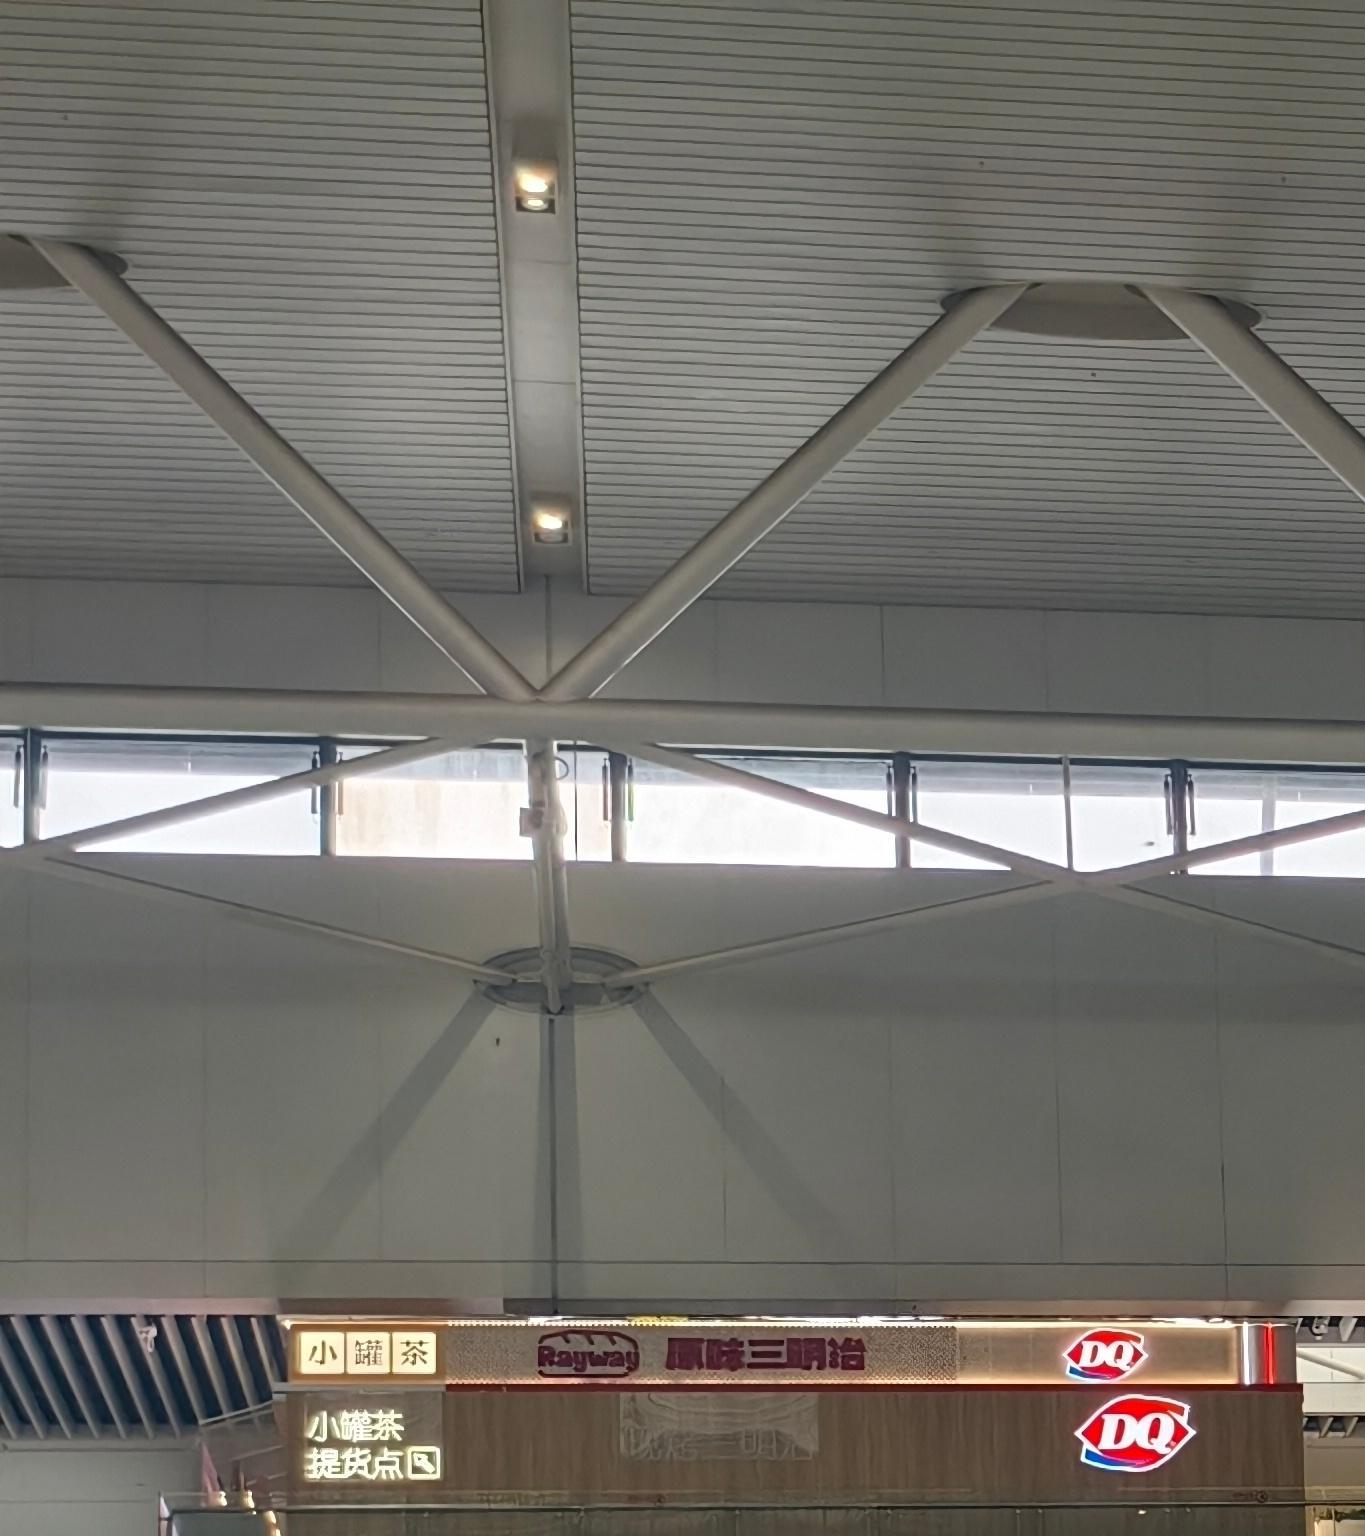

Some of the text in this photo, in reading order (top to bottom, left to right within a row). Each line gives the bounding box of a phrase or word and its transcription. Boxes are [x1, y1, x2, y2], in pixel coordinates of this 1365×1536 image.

[307, 1340, 428, 1367] 小罐茶
[537, 1345, 637, 1372] Rayway
[666, 1337, 865, 1370] 原味三明治
[1078, 1340, 1134, 1371] DQ
[307, 1409, 405, 1441] 小罐茶
[1098, 1412, 1173, 1455] DQ
[305, 1448, 404, 1480] 提货点
